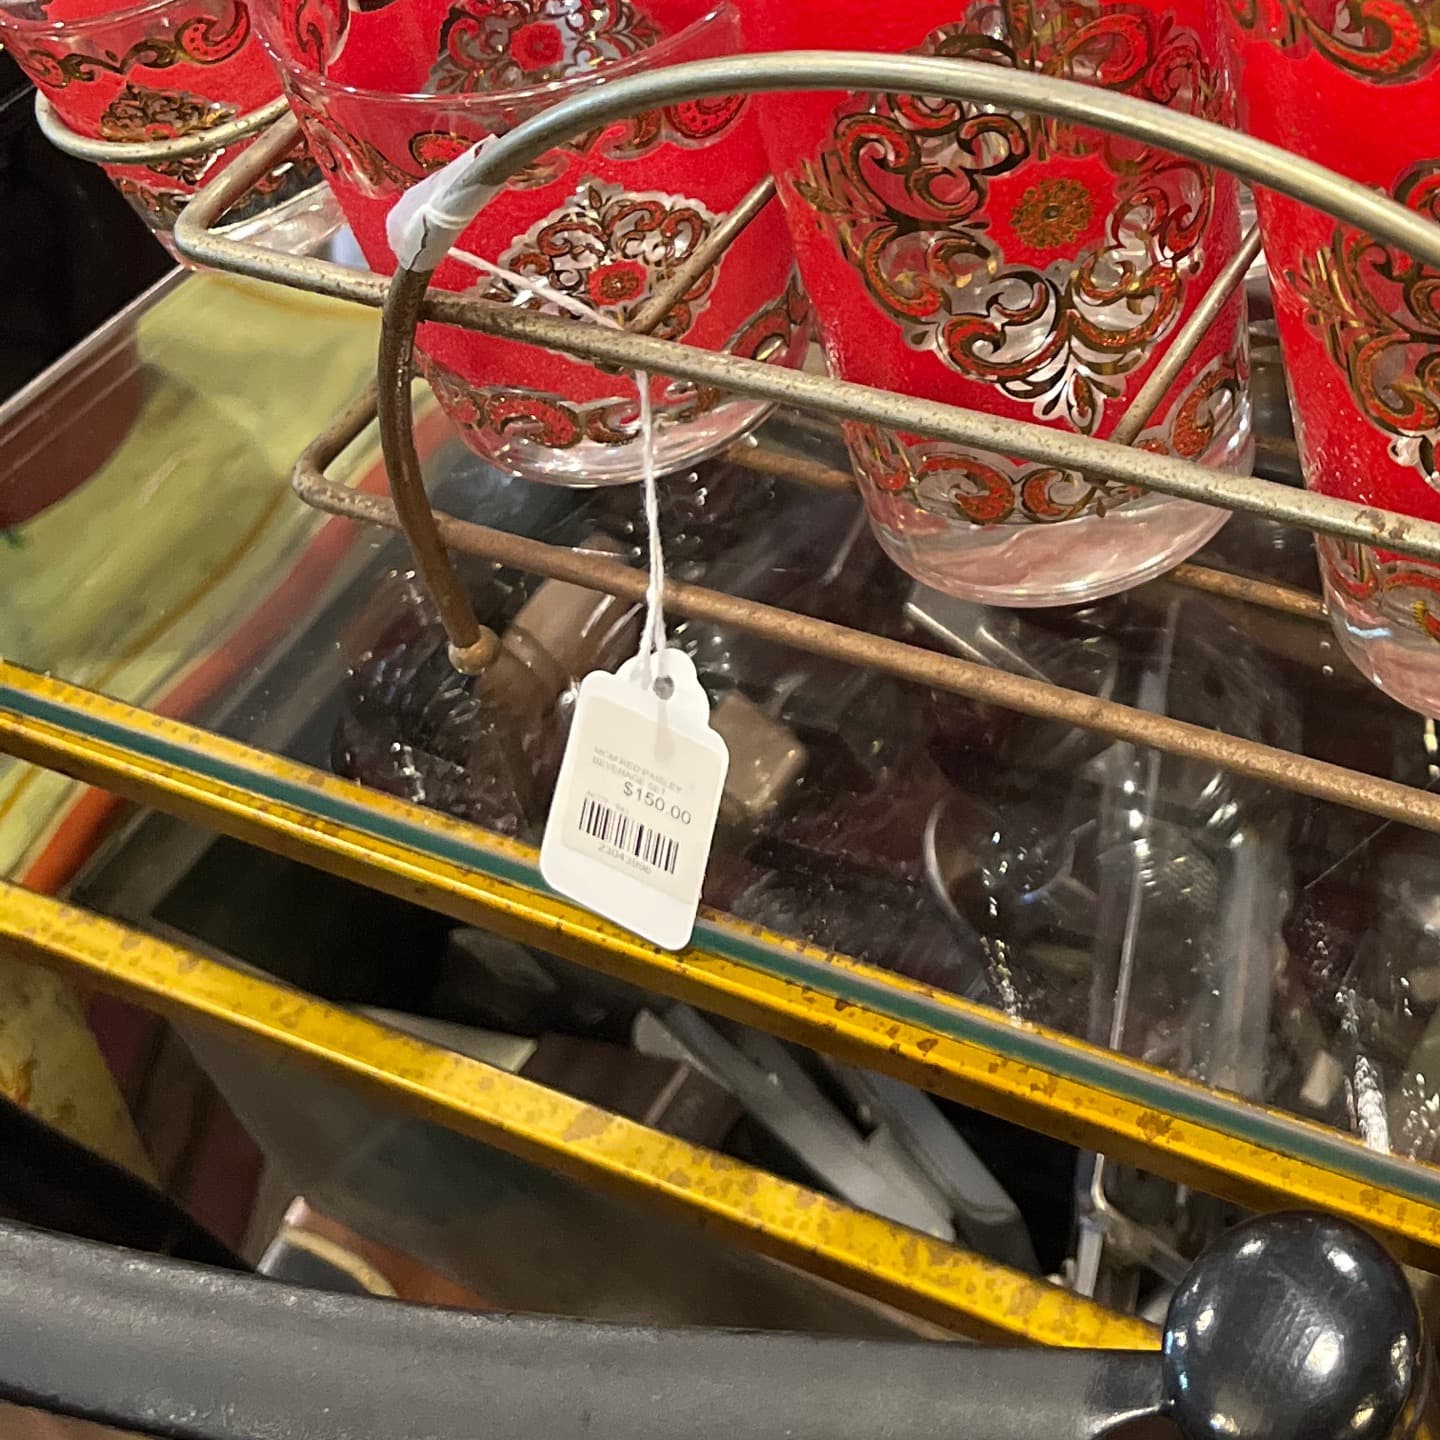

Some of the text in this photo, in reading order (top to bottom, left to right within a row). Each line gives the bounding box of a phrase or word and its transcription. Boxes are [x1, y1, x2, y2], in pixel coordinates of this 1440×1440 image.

[592, 755, 643, 786] BEVERAGE
[618, 756, 641, 772] RED
[641, 768, 683, 793] PAISLEY
[623, 781, 692, 825] $150.00
